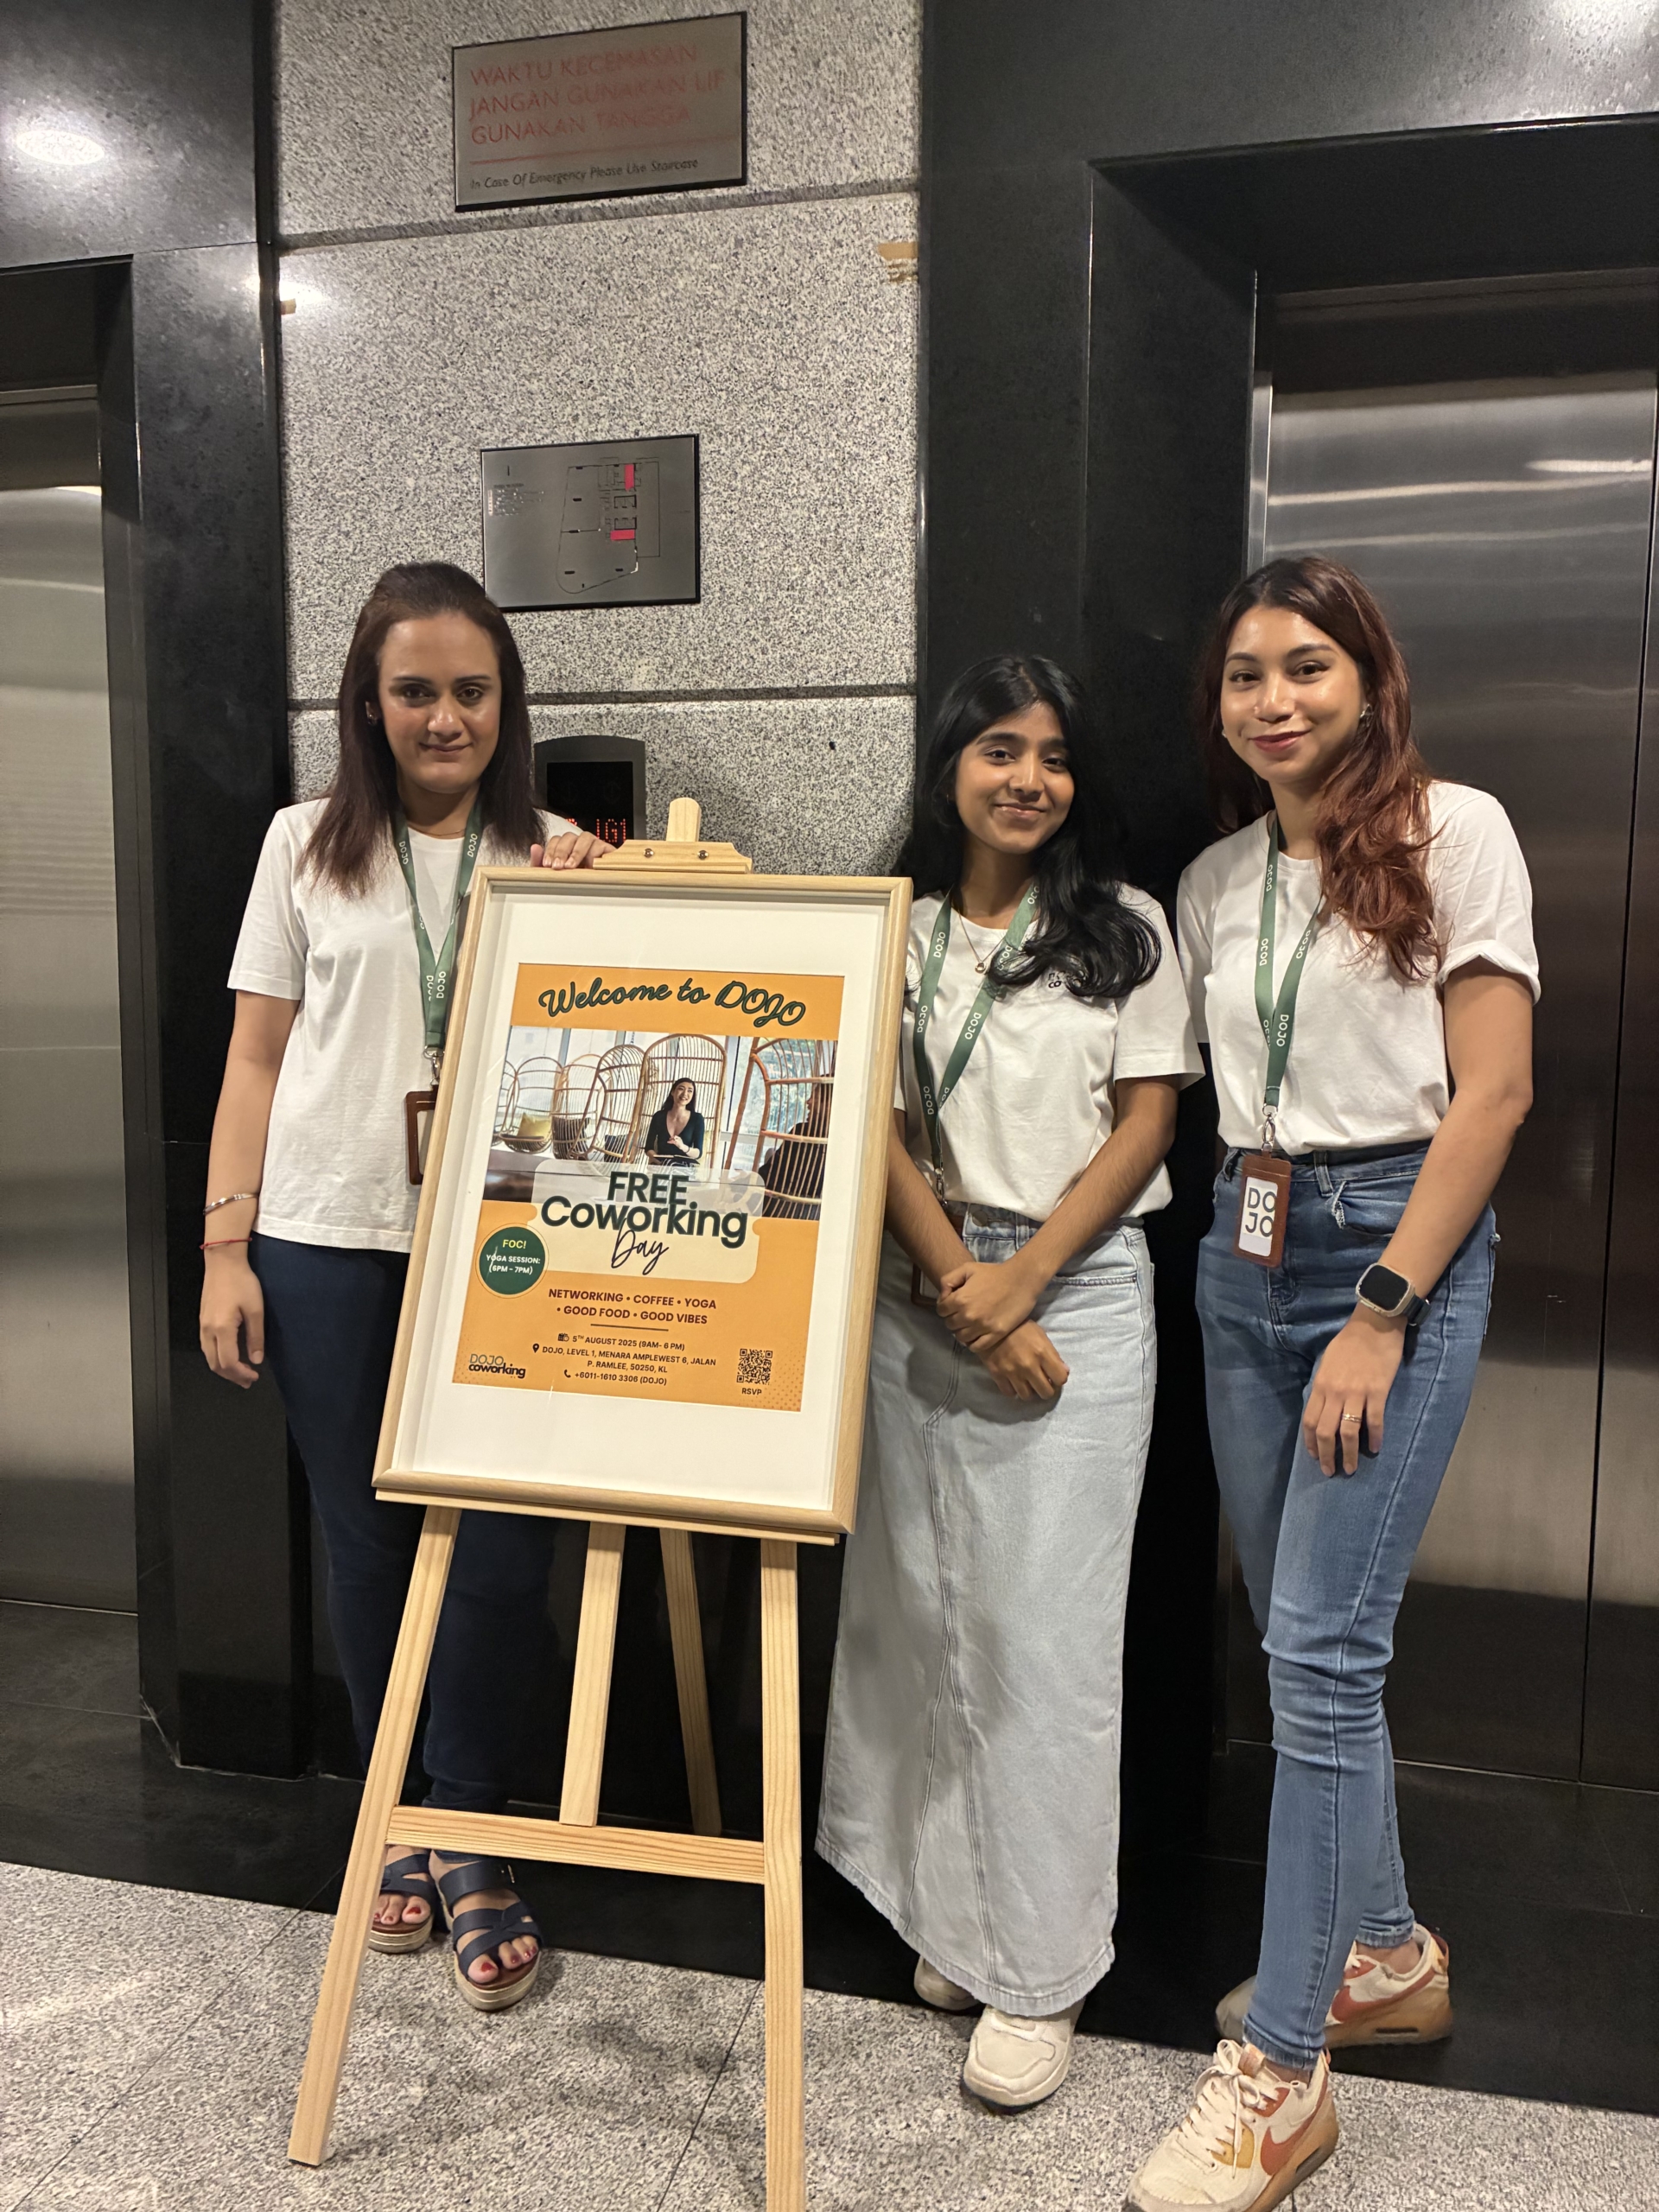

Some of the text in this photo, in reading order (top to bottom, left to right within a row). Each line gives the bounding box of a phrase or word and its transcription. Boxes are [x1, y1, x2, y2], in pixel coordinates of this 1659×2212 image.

[470, 61, 553, 87] WAKTU
[468, 89, 560, 123] JANGAN
[471, 117, 587, 145] GUNAKAN
[484, 176, 510, 189] Case
[512, 173, 529, 188] Of
[528, 171, 587, 185] Emergency
[589, 165, 624, 180] Please
[398, 841, 409, 865] DOJO
[467, 833, 479, 858] DOJO
[933, 931, 946, 958] DOJO
[1260, 938, 1268, 966] DOJO
[436, 971, 447, 999] DOJO
[538, 977, 806, 1027] Welcome to DOJO
[917, 1005, 928, 1033] DOJO
[965, 1012, 982, 1040] DOJO
[1276, 1014, 1289, 1047] DOJO
[924, 1086, 934, 1115] DOJO
[607, 1171, 690, 1205] FREE
[1248, 1187, 1277, 1213] DO
[540, 1195, 748, 1249] Coworking
[1245, 1211, 1274, 1237] JO
[502, 1239, 527, 1249] FOC!
[611, 1218, 670, 1275] Day
[486, 1254, 541, 1264] YOGA SESSION:
[514, 1266, 533, 1275] 7PM)
[549, 1288, 716, 1310] NETWORKING COFFEE YOGA
[563, 1306, 708, 1325] GOOD FOOD GOOD VIBES
[542, 1346, 565, 1355] DOJO,
[598, 1351, 631, 1360] MENARA
[632, 1353, 680, 1363] AMPLEWEST
[682, 1357, 690, 1365] 6,
[690, 1357, 716, 1366] JALAN
[585, 1337, 616, 1345] AUGUST
[639, 1340, 662, 1350] (9AM-
[671, 1343, 685, 1351] PM)
[468, 1362, 526, 1379] coworking
[469, 1353, 505, 1366] DOJO
[595, 1361, 628, 1371] RAMLEE,
[630, 1364, 657, 1373] 50250,
[575, 1371, 617, 1381] +6011-1610
[639, 1376, 667, 1386] (DOJO)
